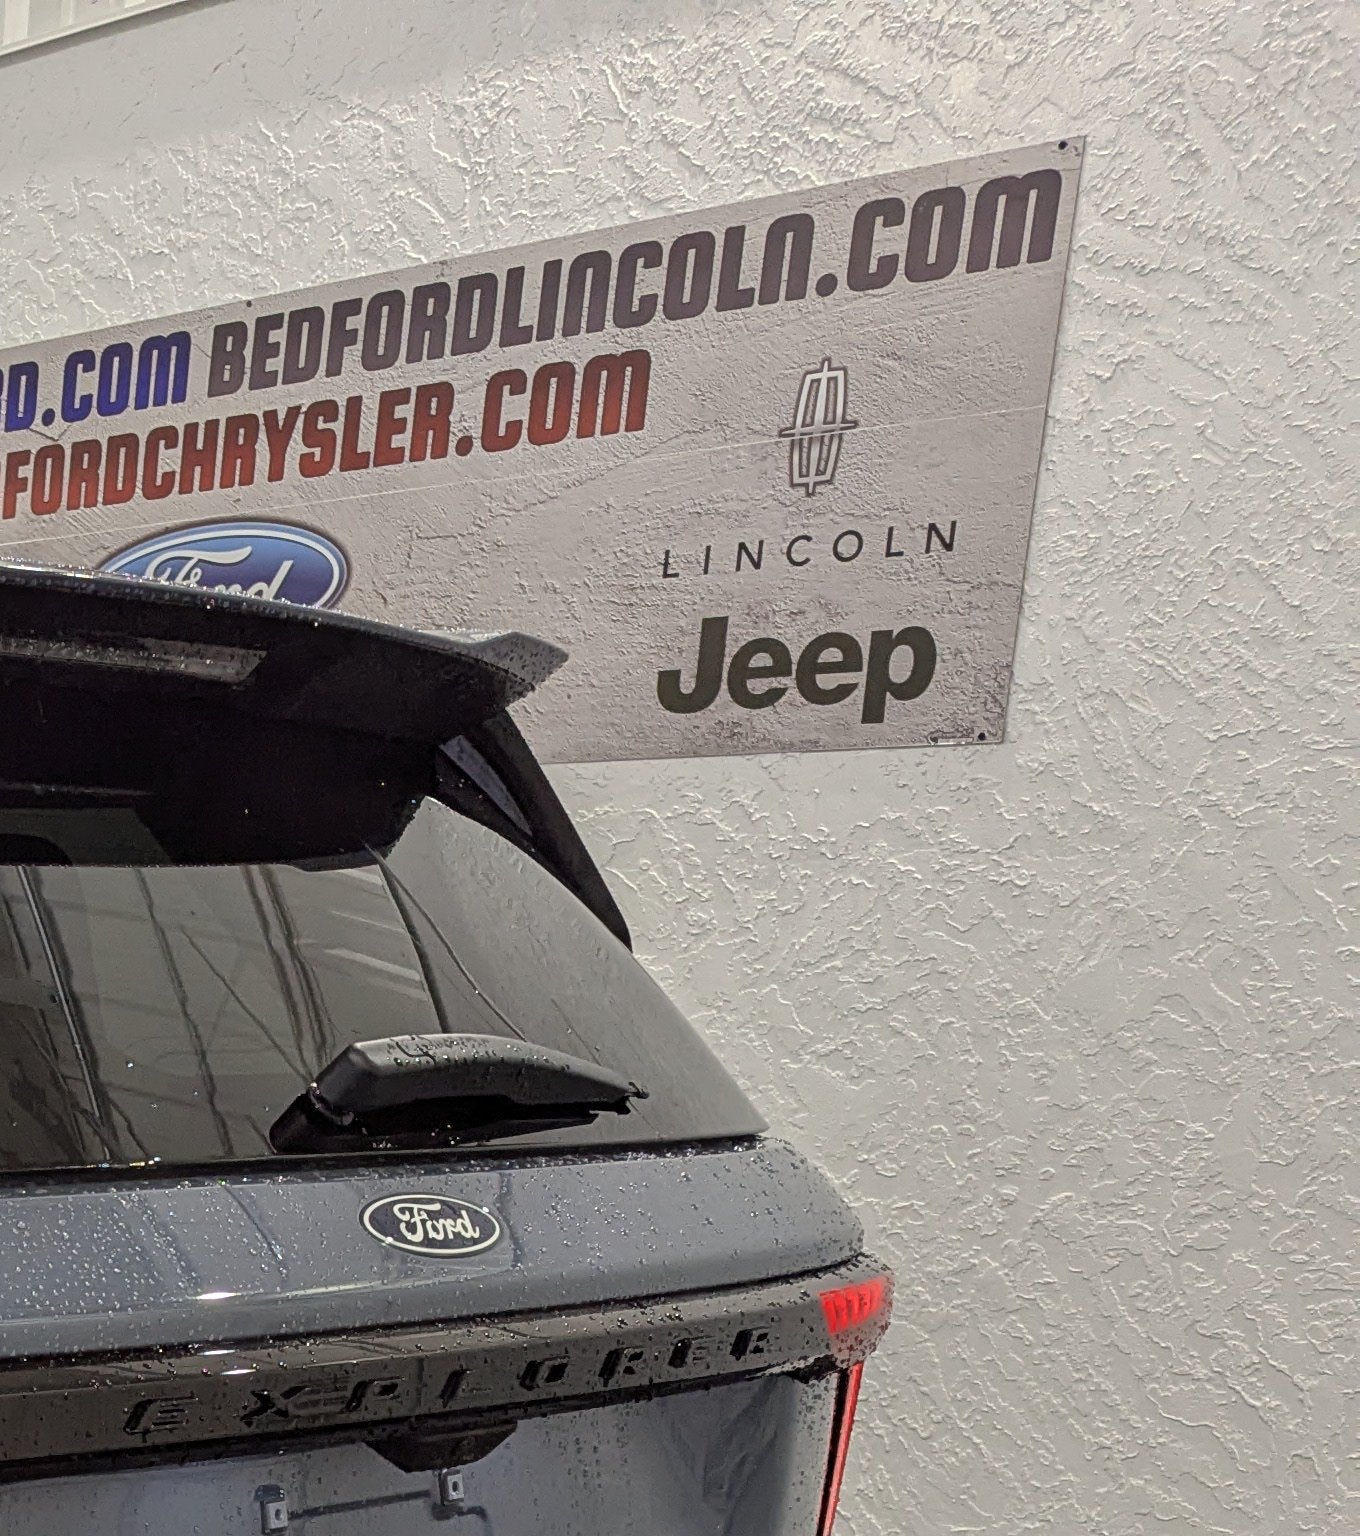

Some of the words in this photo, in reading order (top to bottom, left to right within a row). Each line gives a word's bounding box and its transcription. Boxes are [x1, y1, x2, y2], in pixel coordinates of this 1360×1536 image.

[207, 168, 1064, 398] BEDFORDLINCOLN.COM
[661, 520, 958, 580] LINCOLN
[656, 615, 938, 725] Jeep
[392, 1201, 481, 1243] Ford
